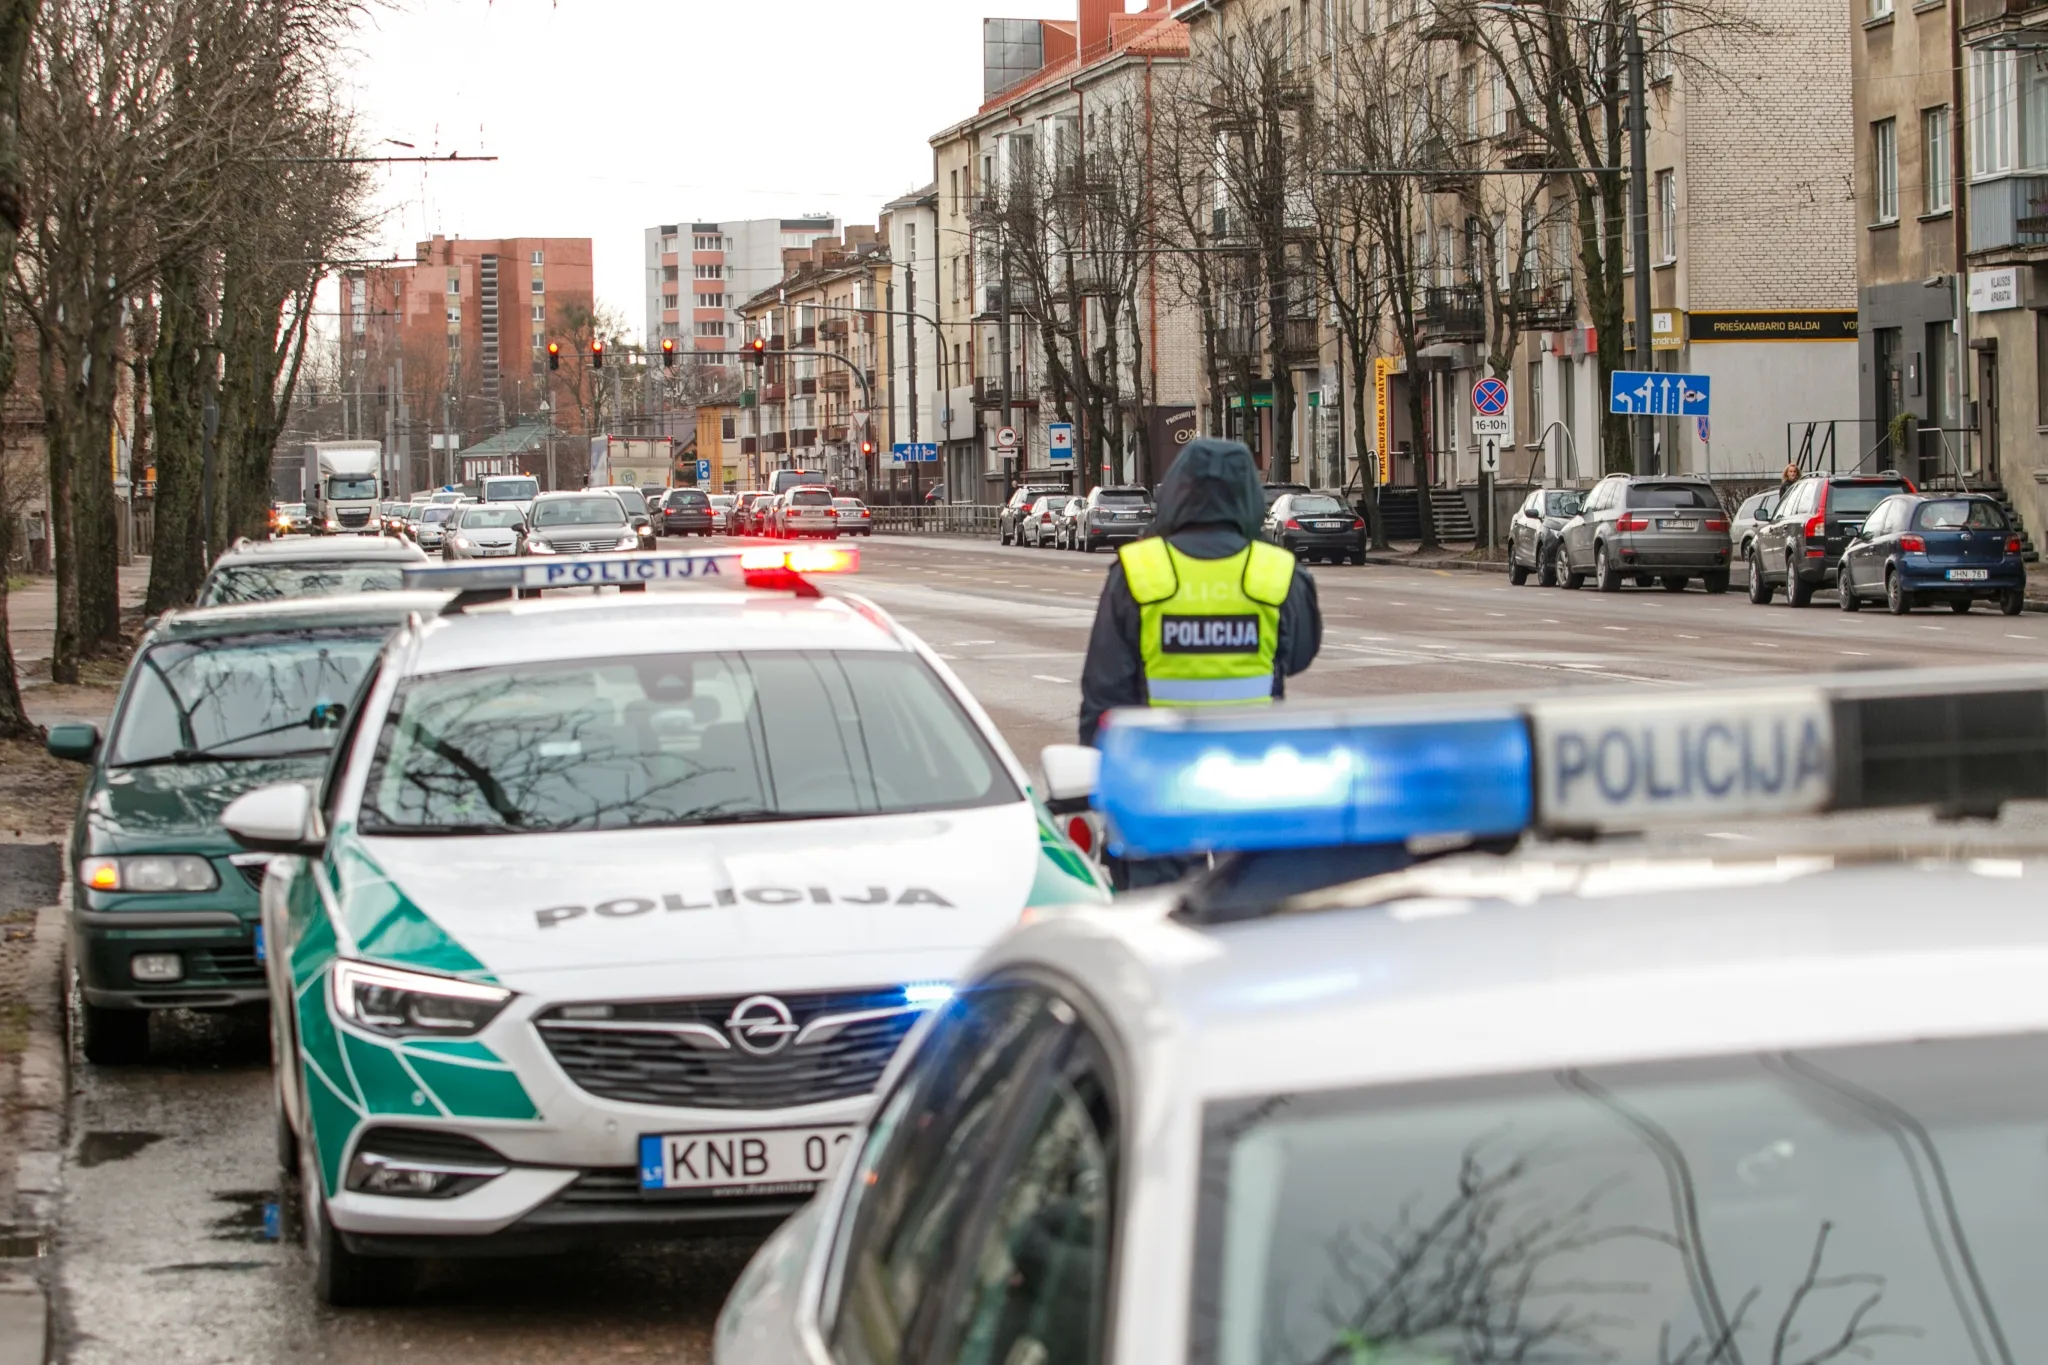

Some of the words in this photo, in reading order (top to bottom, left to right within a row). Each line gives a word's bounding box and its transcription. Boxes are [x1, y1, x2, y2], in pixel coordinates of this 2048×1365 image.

[1991, 276, 2010, 288] KLAUSOS
[1991, 290, 2012, 302] APARATAI
[1714, 320, 1785, 331] PRIEŠKAMBARIO
[1788, 321, 1820, 330] BALDAI
[1652, 337, 1680, 345] endrus
[1377, 364, 1385, 405] AVALYNĖ
[549, 558, 720, 582] POLICIJA
[1163, 620, 1258, 646] POLICIJA
[1556, 716, 1830, 805] POLICIJA
[534, 887, 958, 929] POLICIJA
[671, 1139, 769, 1180] KNB
